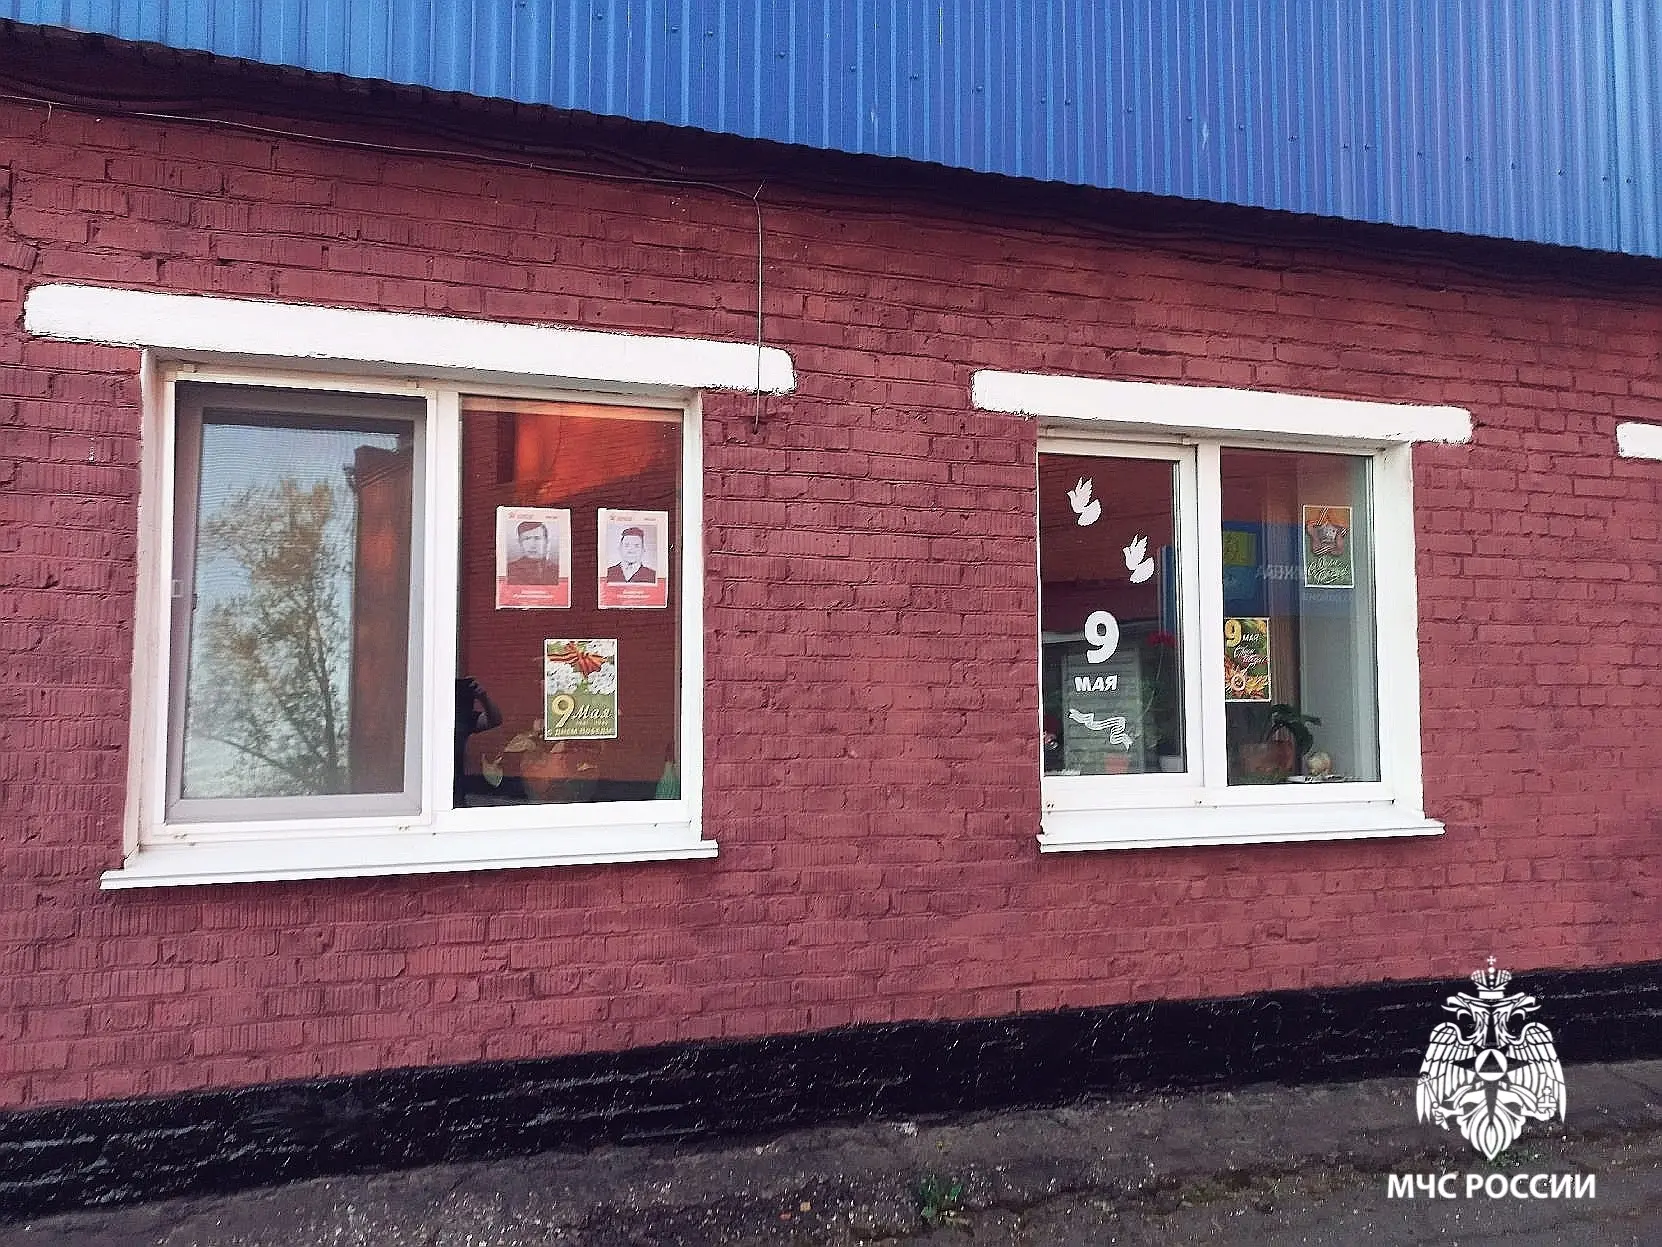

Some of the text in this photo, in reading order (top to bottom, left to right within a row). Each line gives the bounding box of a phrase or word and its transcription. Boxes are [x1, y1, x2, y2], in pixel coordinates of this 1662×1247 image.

[1084, 610, 1120, 664] 9
[1224, 619, 1242, 648] 9
[1074, 674, 1118, 692] МАЯ
[551, 694, 575, 729] 9
